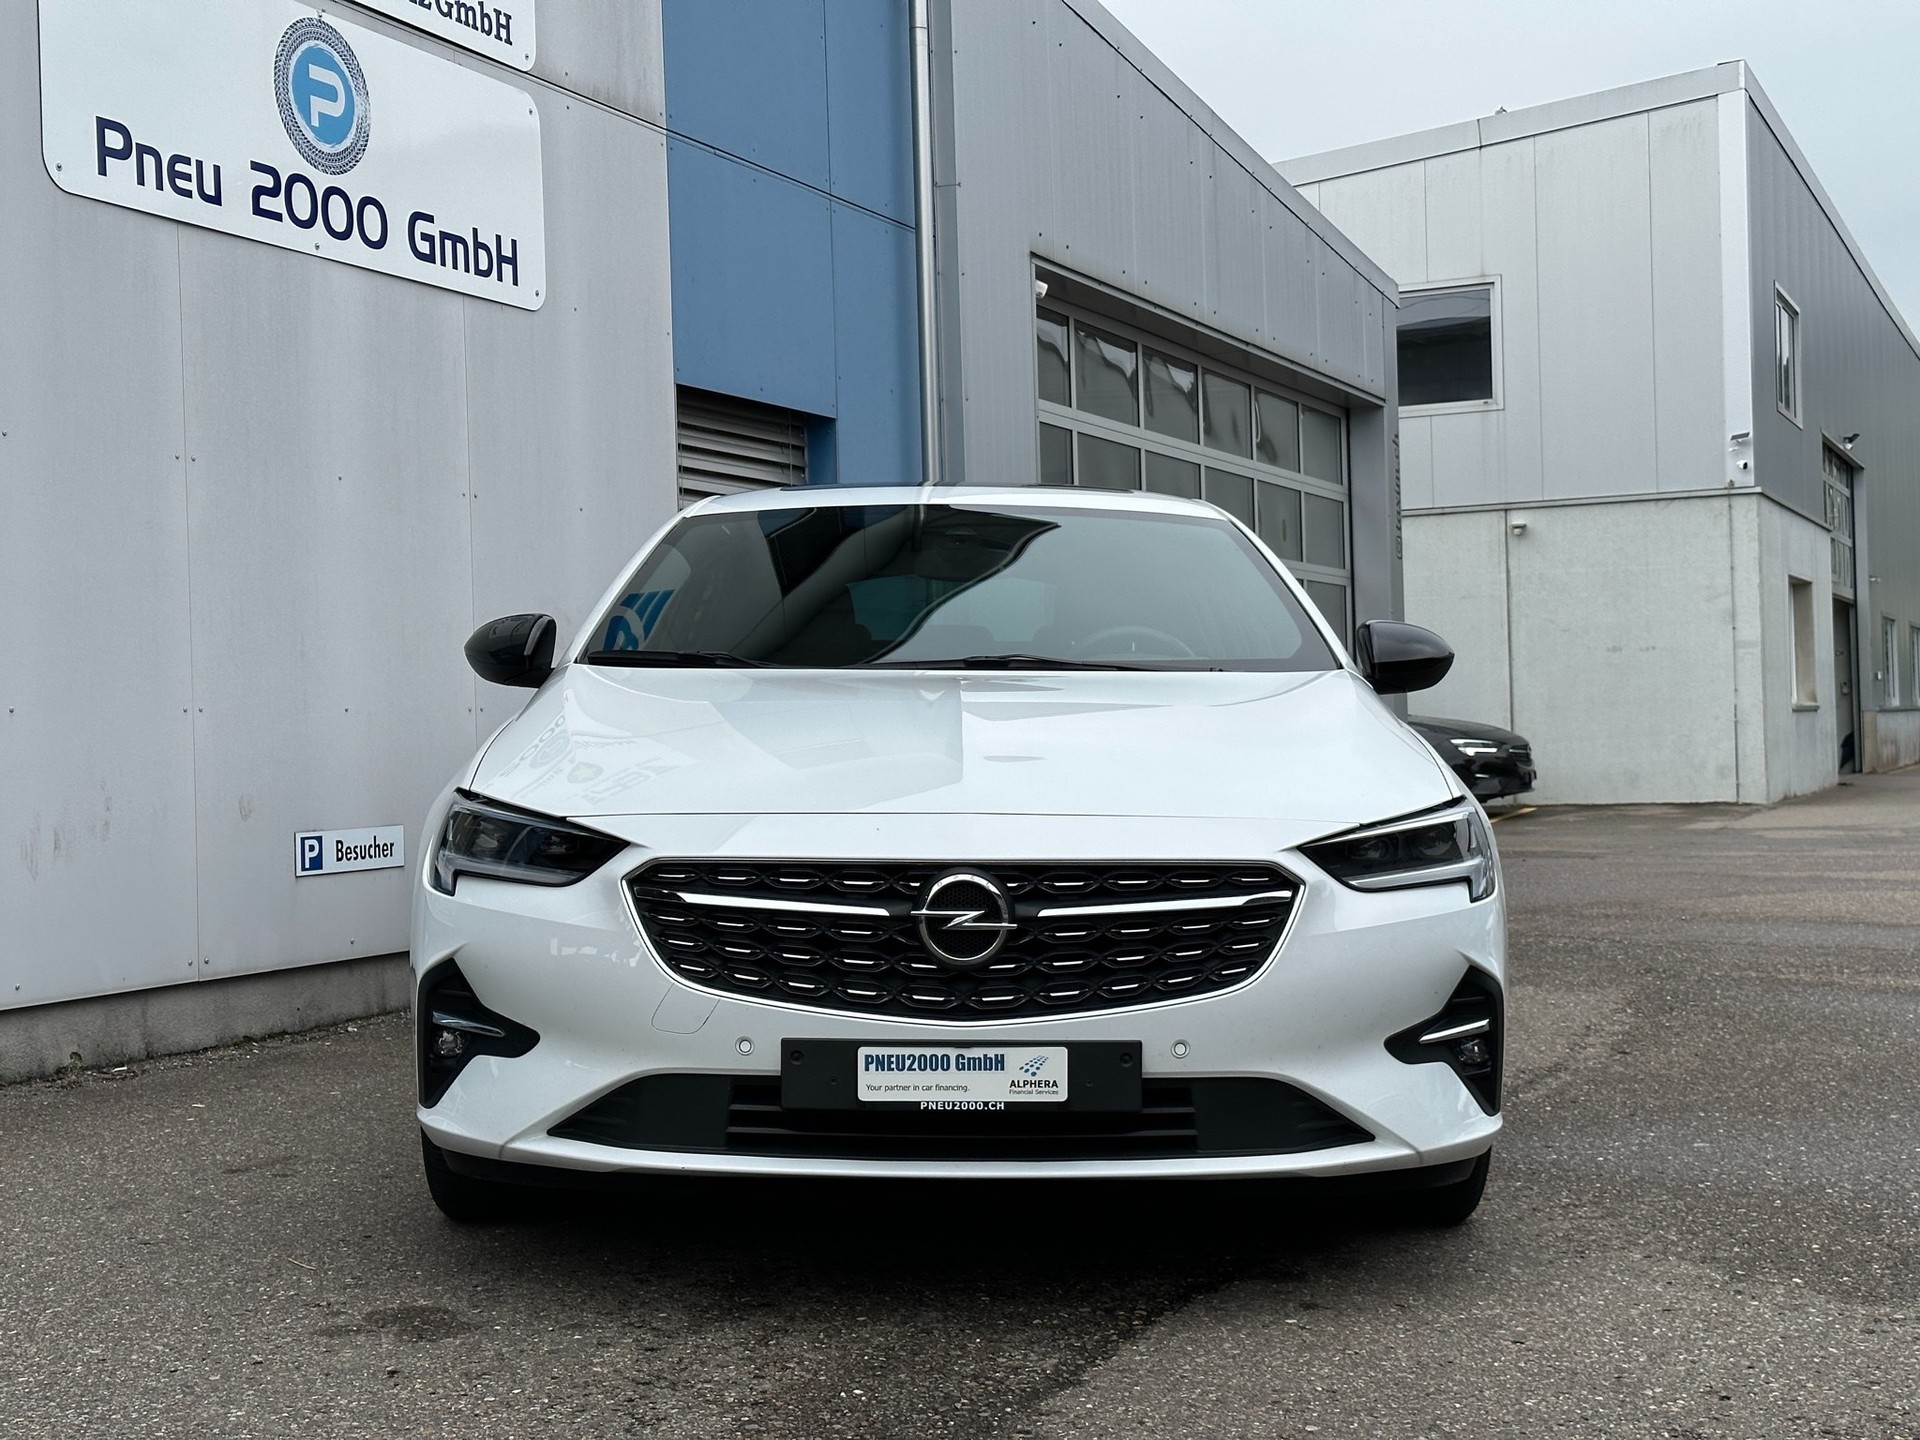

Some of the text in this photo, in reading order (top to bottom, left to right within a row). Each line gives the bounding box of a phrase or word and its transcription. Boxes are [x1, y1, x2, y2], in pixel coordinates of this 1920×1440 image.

[95, 115, 519, 287] Pneu 2000 GmbH
[304, 835, 395, 869] P Besucher
[864, 1053, 1005, 1072] PNEU2000 GmbH
[866, 1082, 971, 1093] Your partner in car financing.
[1009, 1079, 1059, 1089] ALPHERA
[1009, 1088, 1059, 1096] Financial Services
[920, 1101, 1005, 1111] PNEU2000.CH
